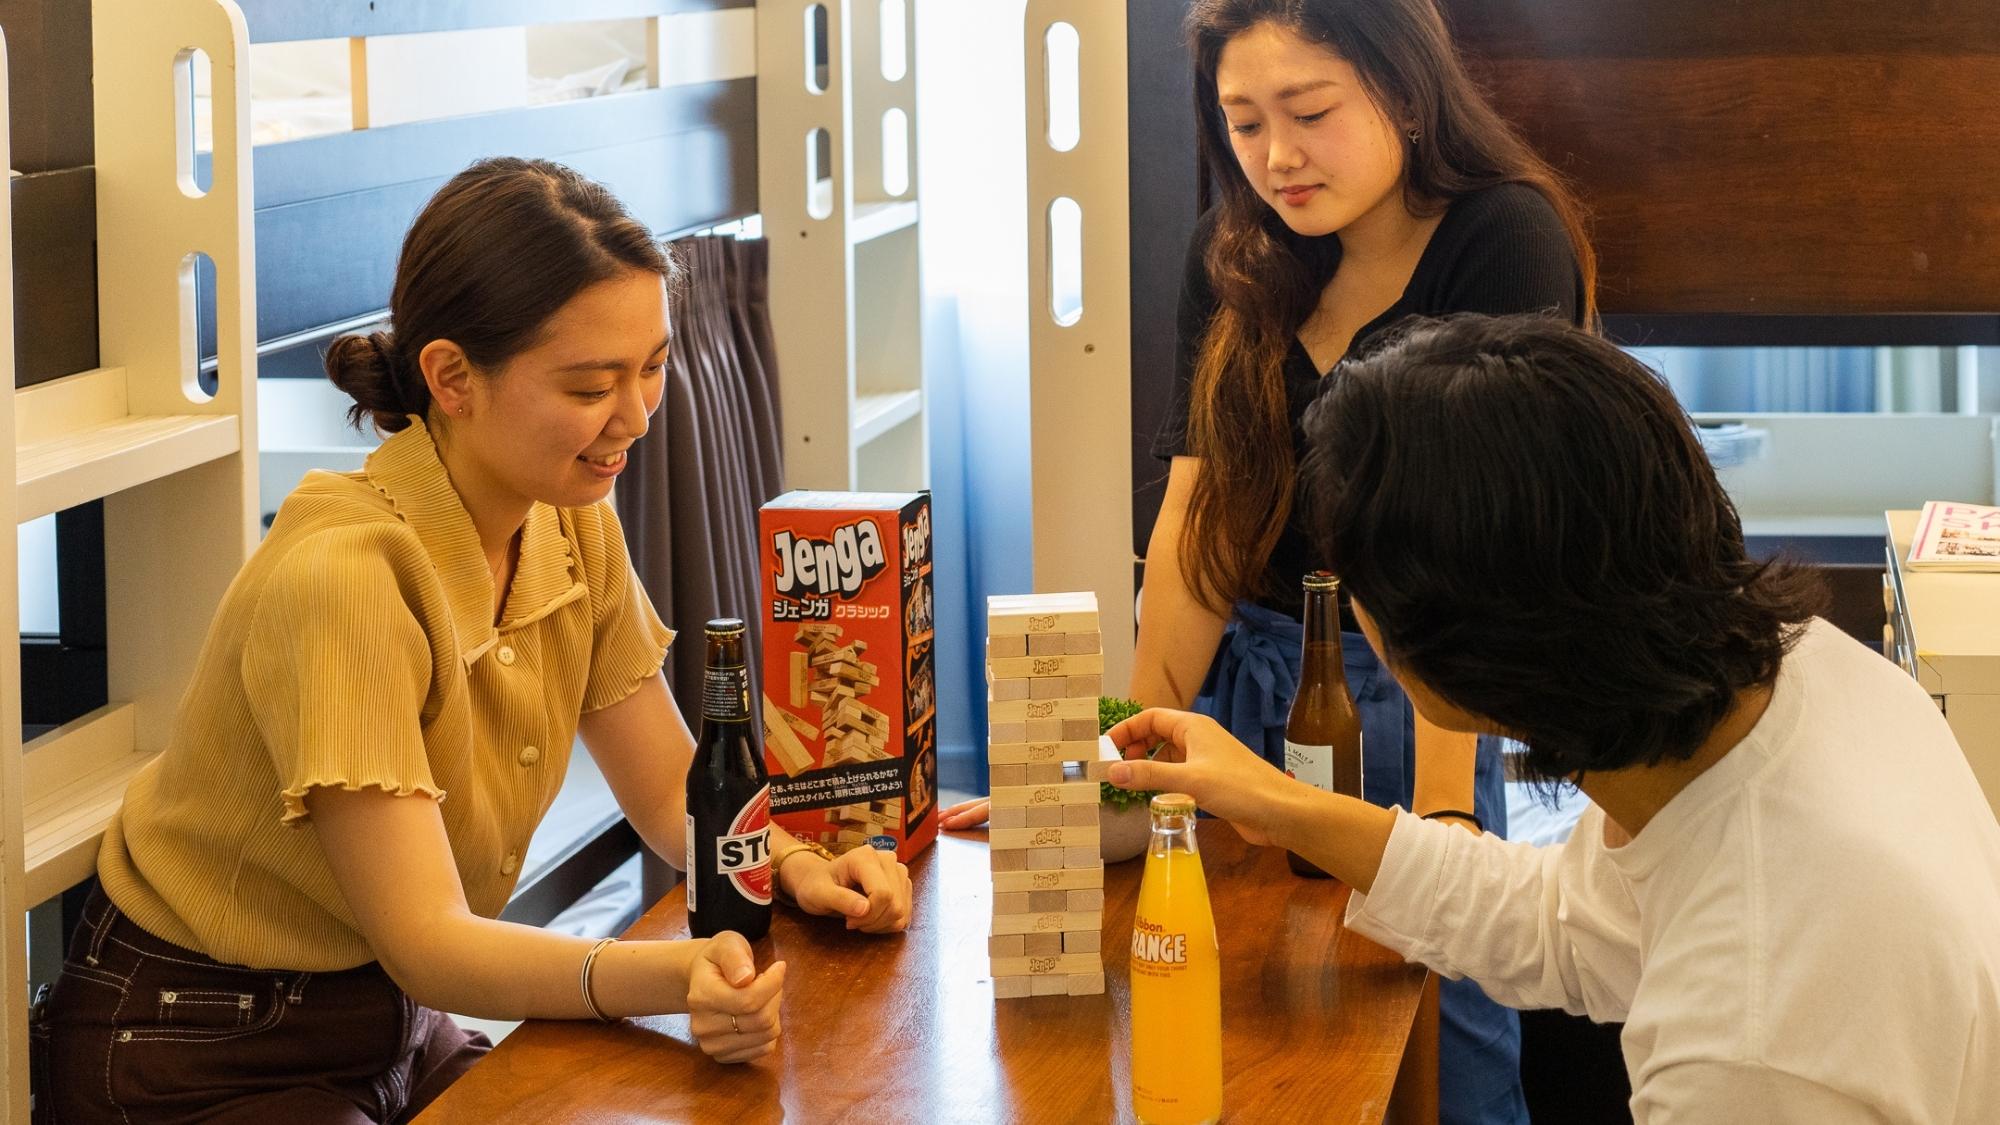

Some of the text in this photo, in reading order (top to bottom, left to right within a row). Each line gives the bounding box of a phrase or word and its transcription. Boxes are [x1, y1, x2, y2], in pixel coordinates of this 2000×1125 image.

[903, 507, 930, 569] Jenga
[774, 520, 884, 594] Jenga
[774, 598, 890, 618] ジェンガ クラシック
[1028, 616, 1055, 632] Jenga
[1033, 659, 1060, 675] Jenga
[1027, 702, 1053, 718] Jenga
[1029, 957, 1056, 973] Jenga
